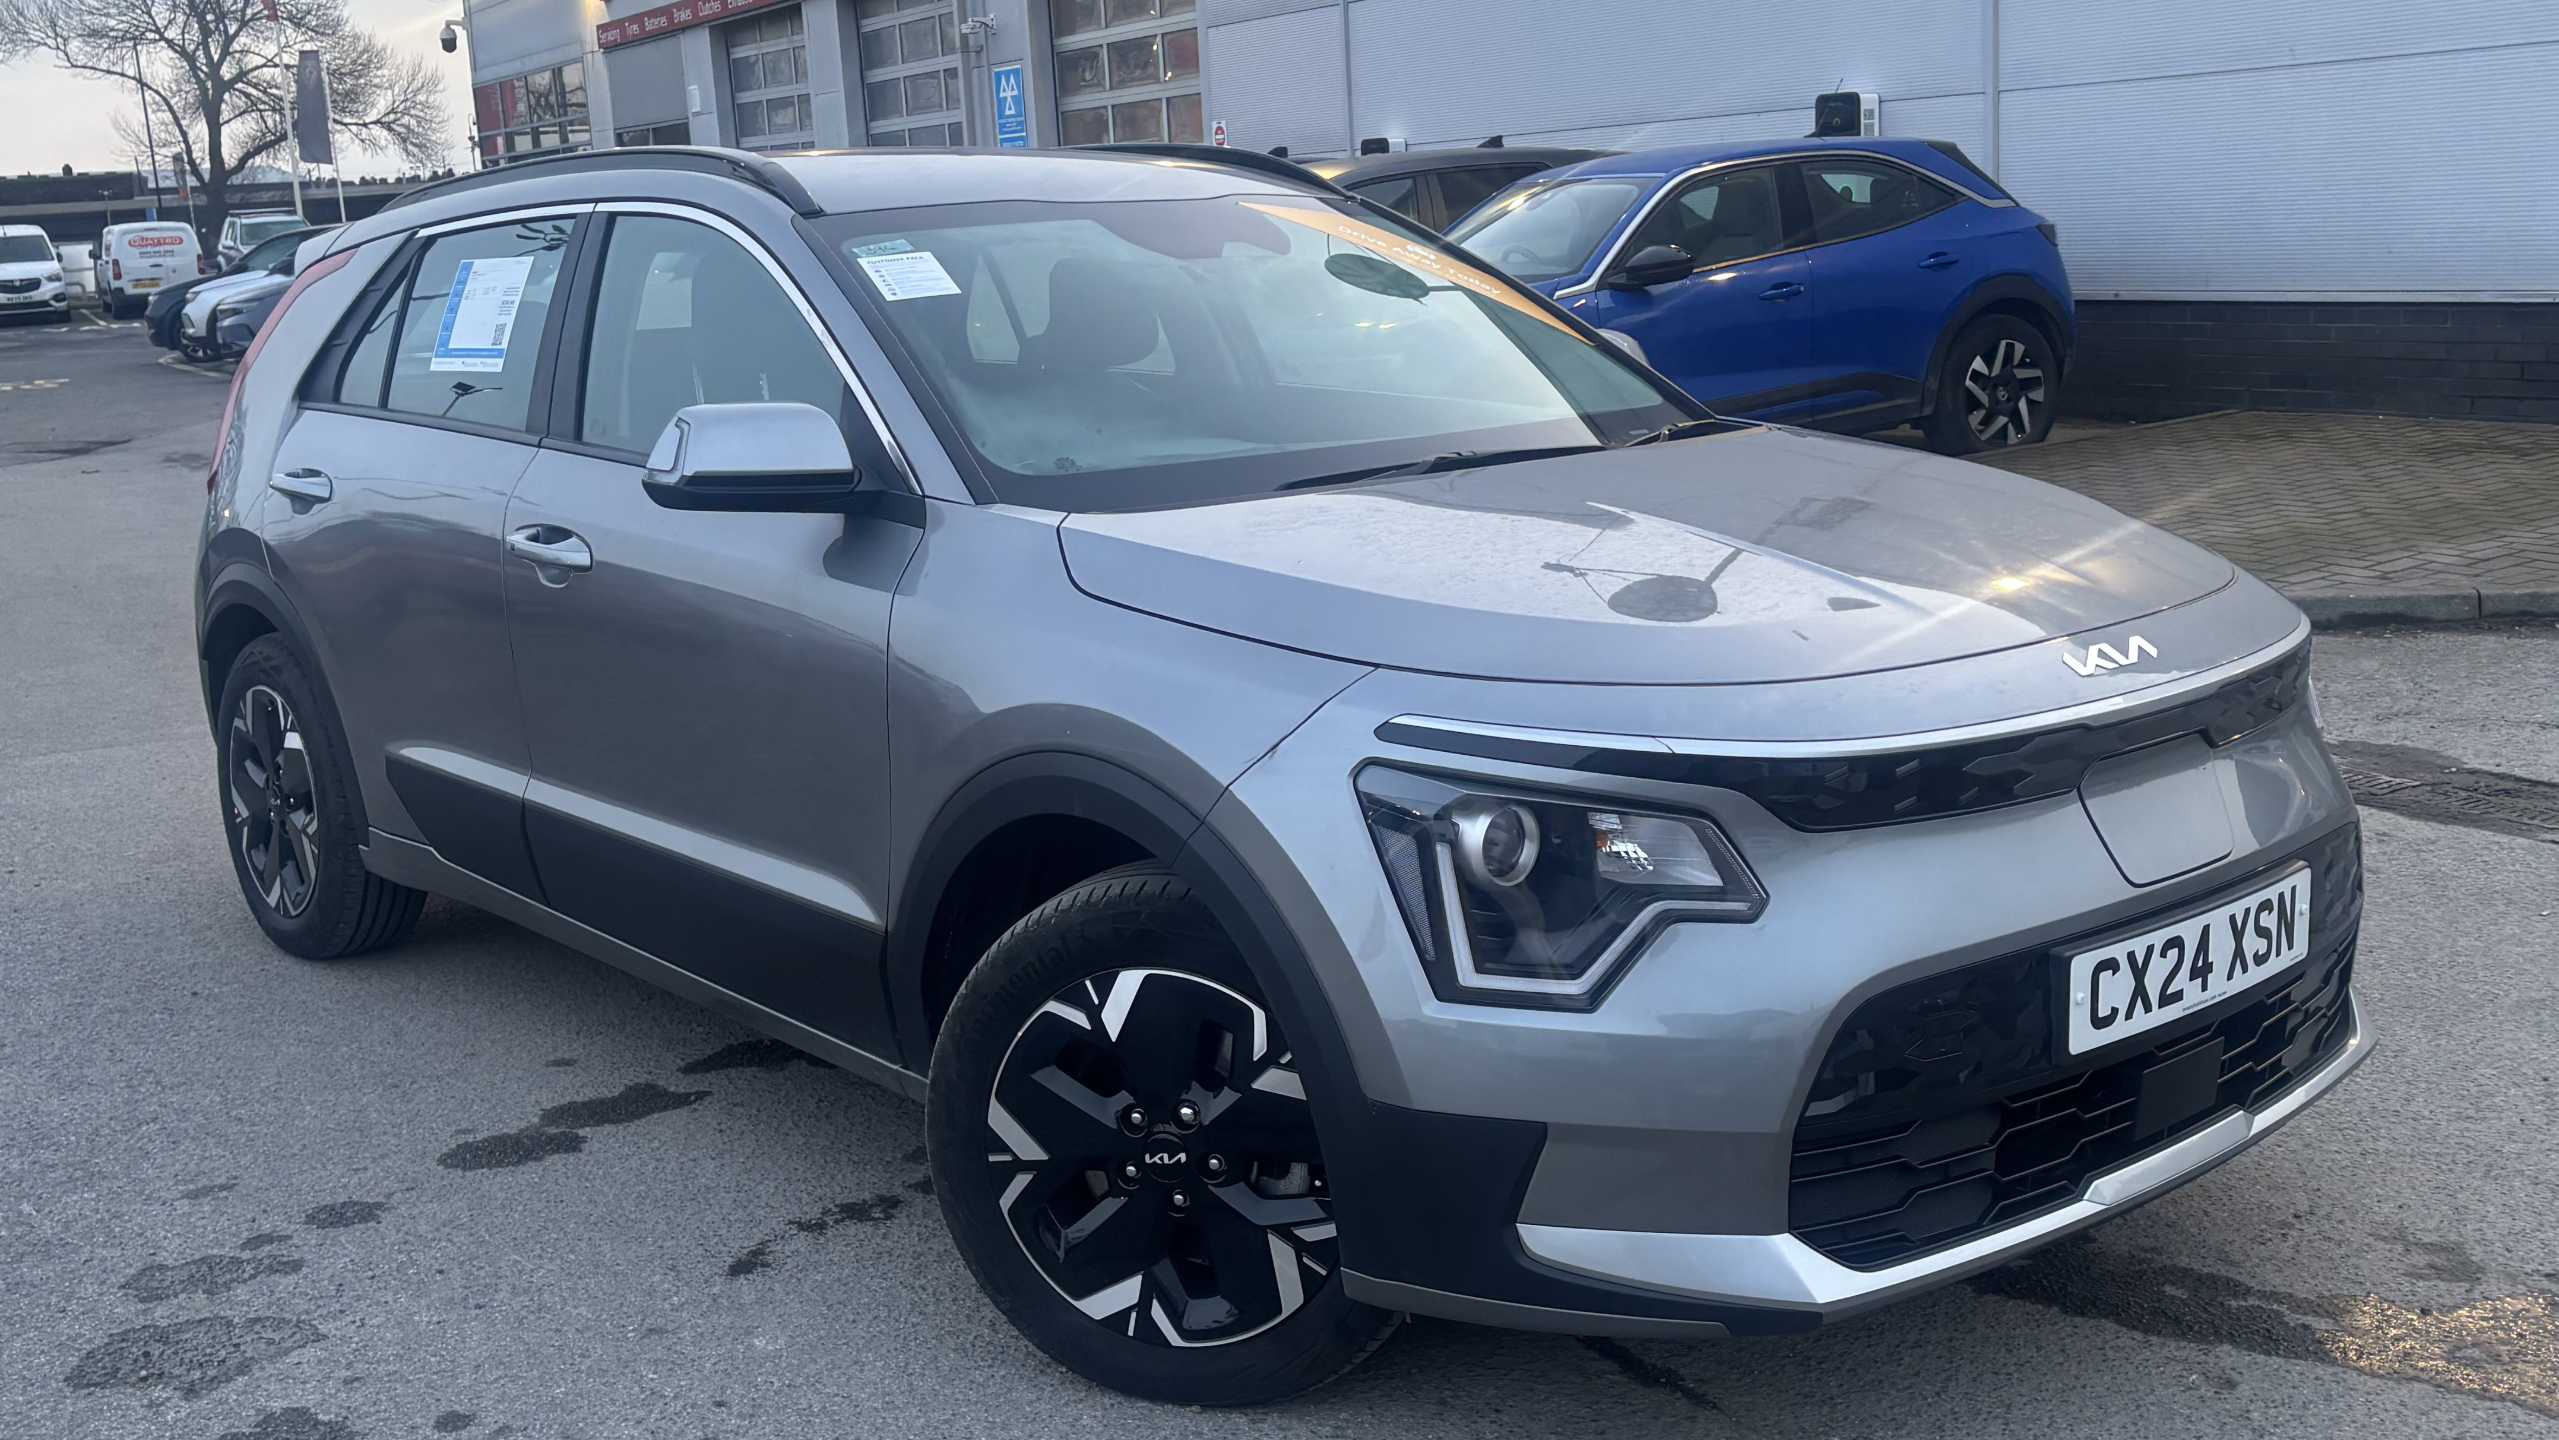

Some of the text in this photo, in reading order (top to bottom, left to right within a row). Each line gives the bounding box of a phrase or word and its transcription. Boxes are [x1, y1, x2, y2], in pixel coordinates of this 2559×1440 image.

[624, 22, 640, 40] Tyres
[672, 8, 692, 23] Brakes
[1337, 224, 1387, 247] Drive
[2089, 884, 2298, 1031] CX24 XSN
